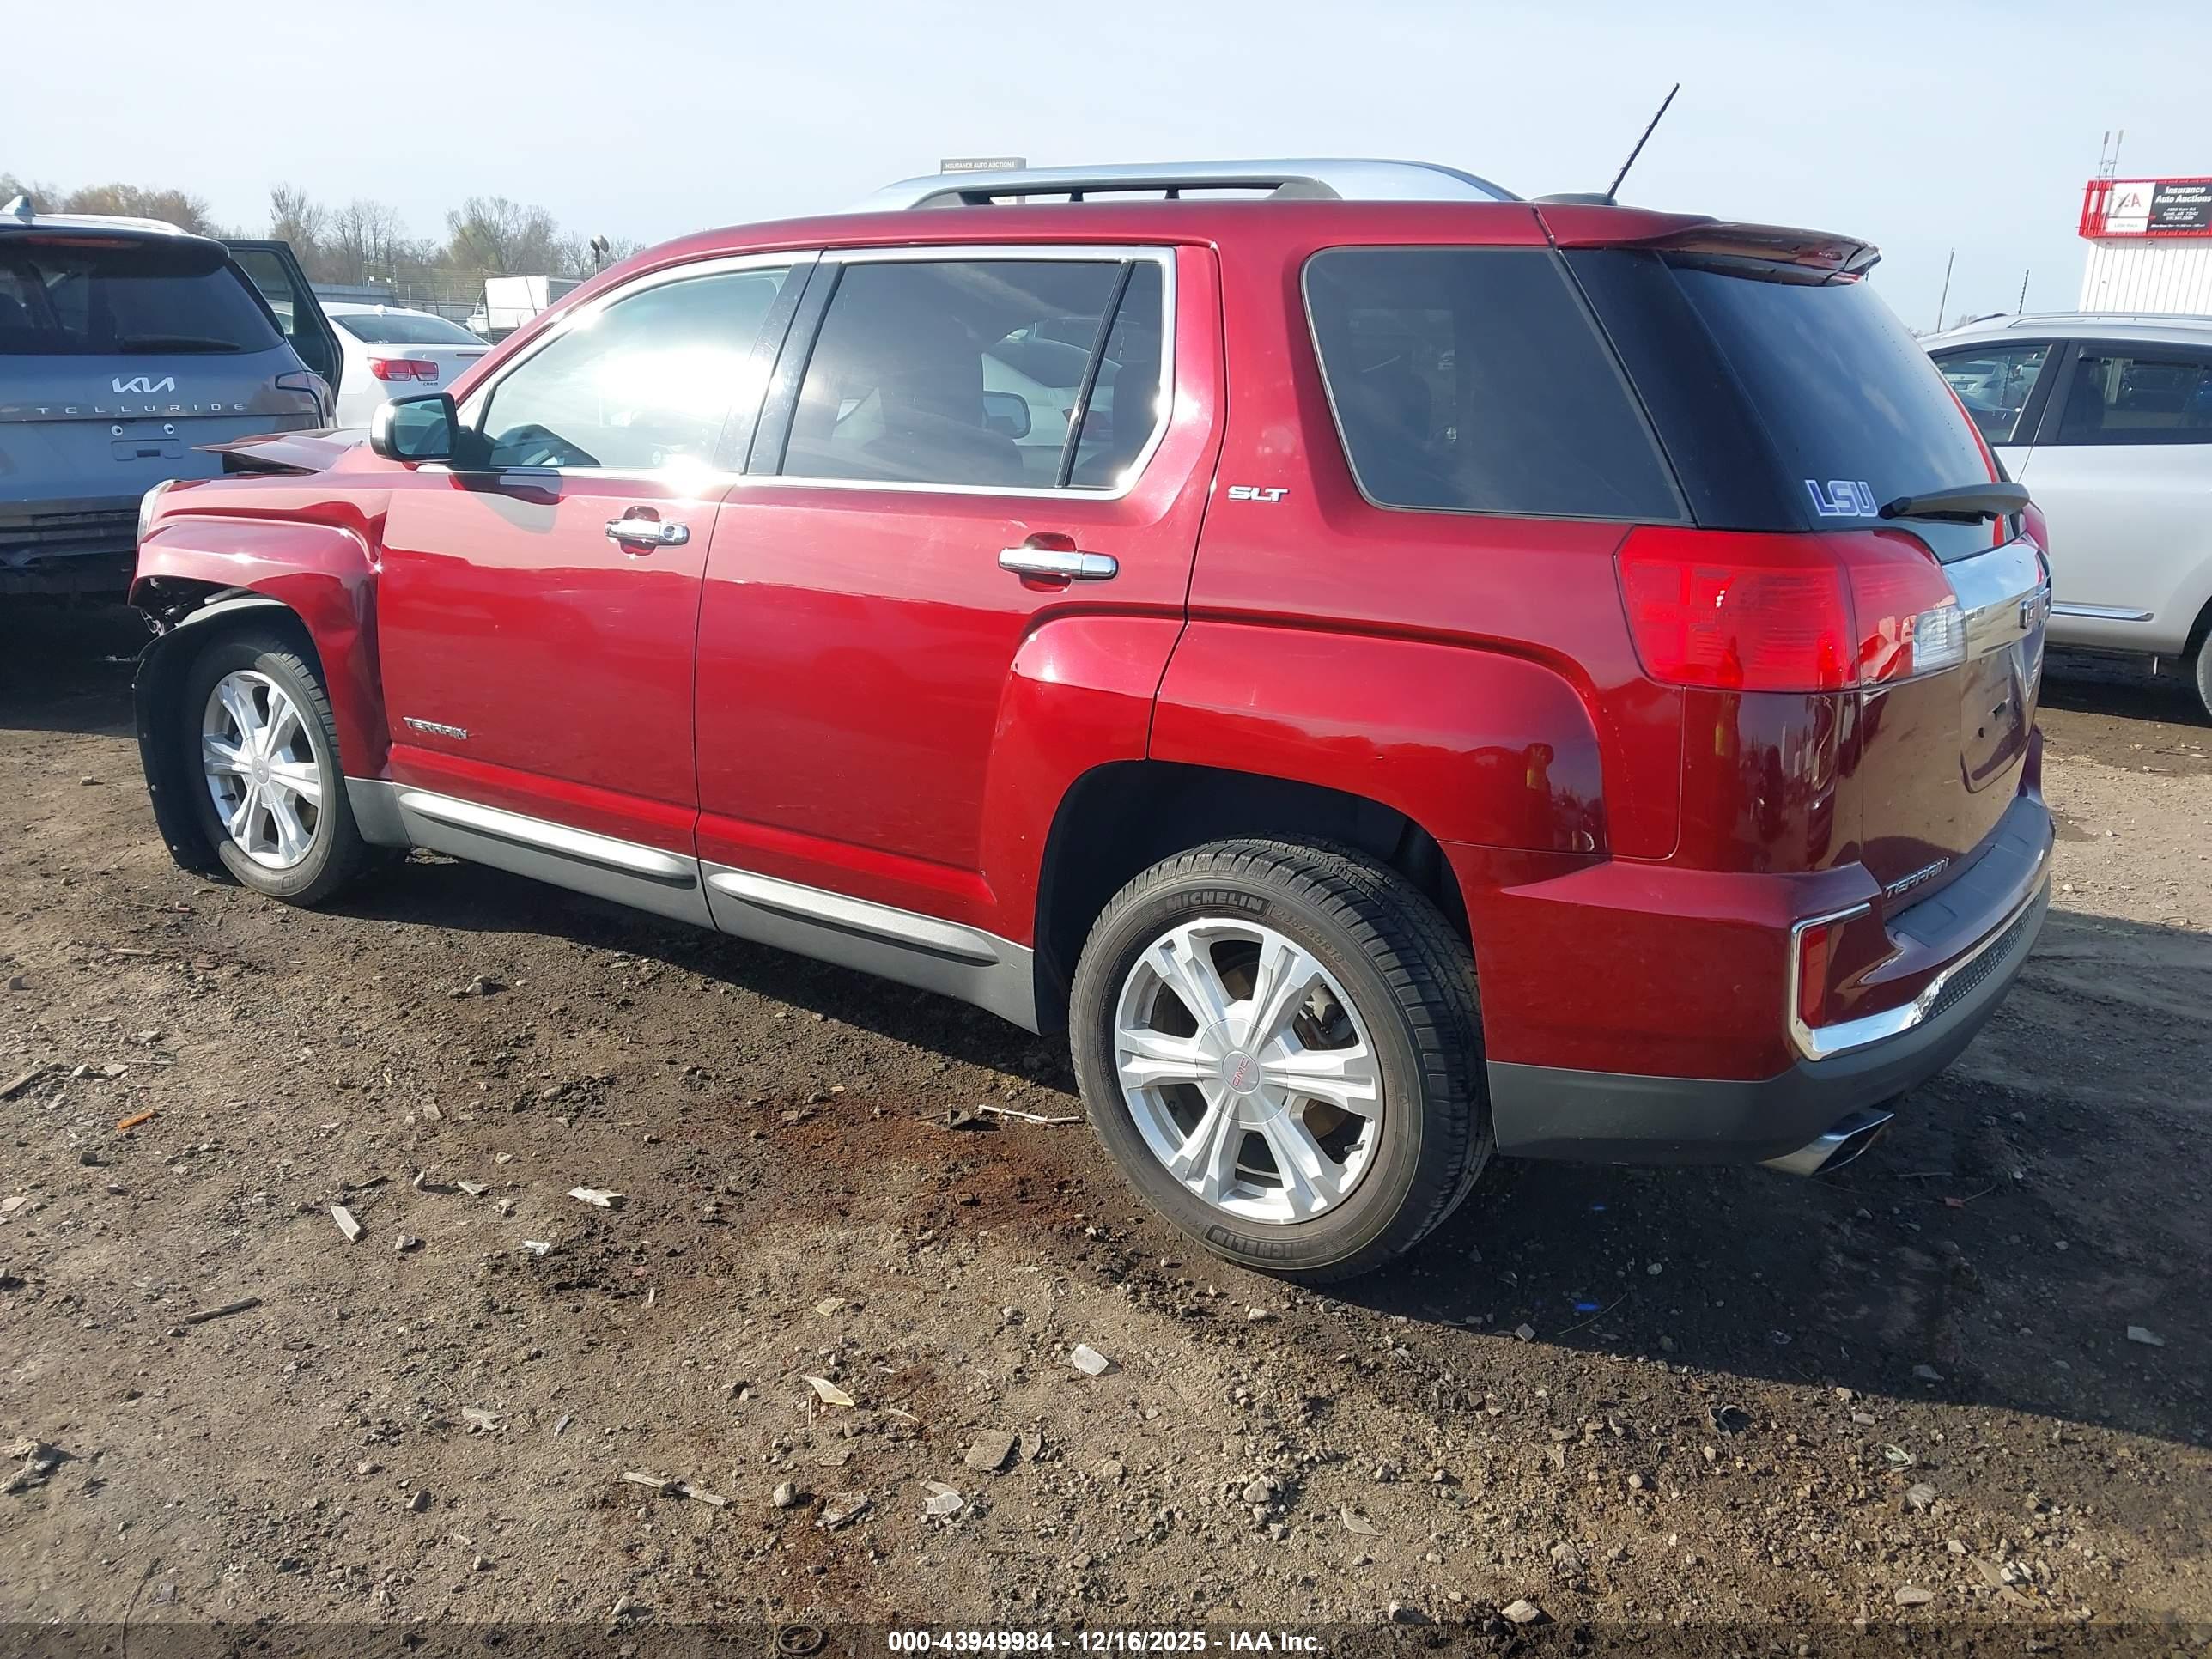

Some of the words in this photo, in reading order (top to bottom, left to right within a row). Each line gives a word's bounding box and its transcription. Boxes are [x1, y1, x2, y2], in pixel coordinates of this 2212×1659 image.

[2155, 194, 2175, 204] Auto
[2175, 193, 2212, 203] Auctions
[112, 376, 175, 393] KIA
[35, 403, 247, 414] TELLURIDE
[1228, 485, 1290, 502] SLT
[1804, 479, 1879, 517] LSU
[402, 715, 468, 740] TERRAIN
[1885, 856, 1950, 899] TERRAIN
[1164, 890, 1266, 912] MICHELIN
[1231, 1056, 1250, 1087] GMC
[1209, 1228, 1310, 1258] MICHELIN
